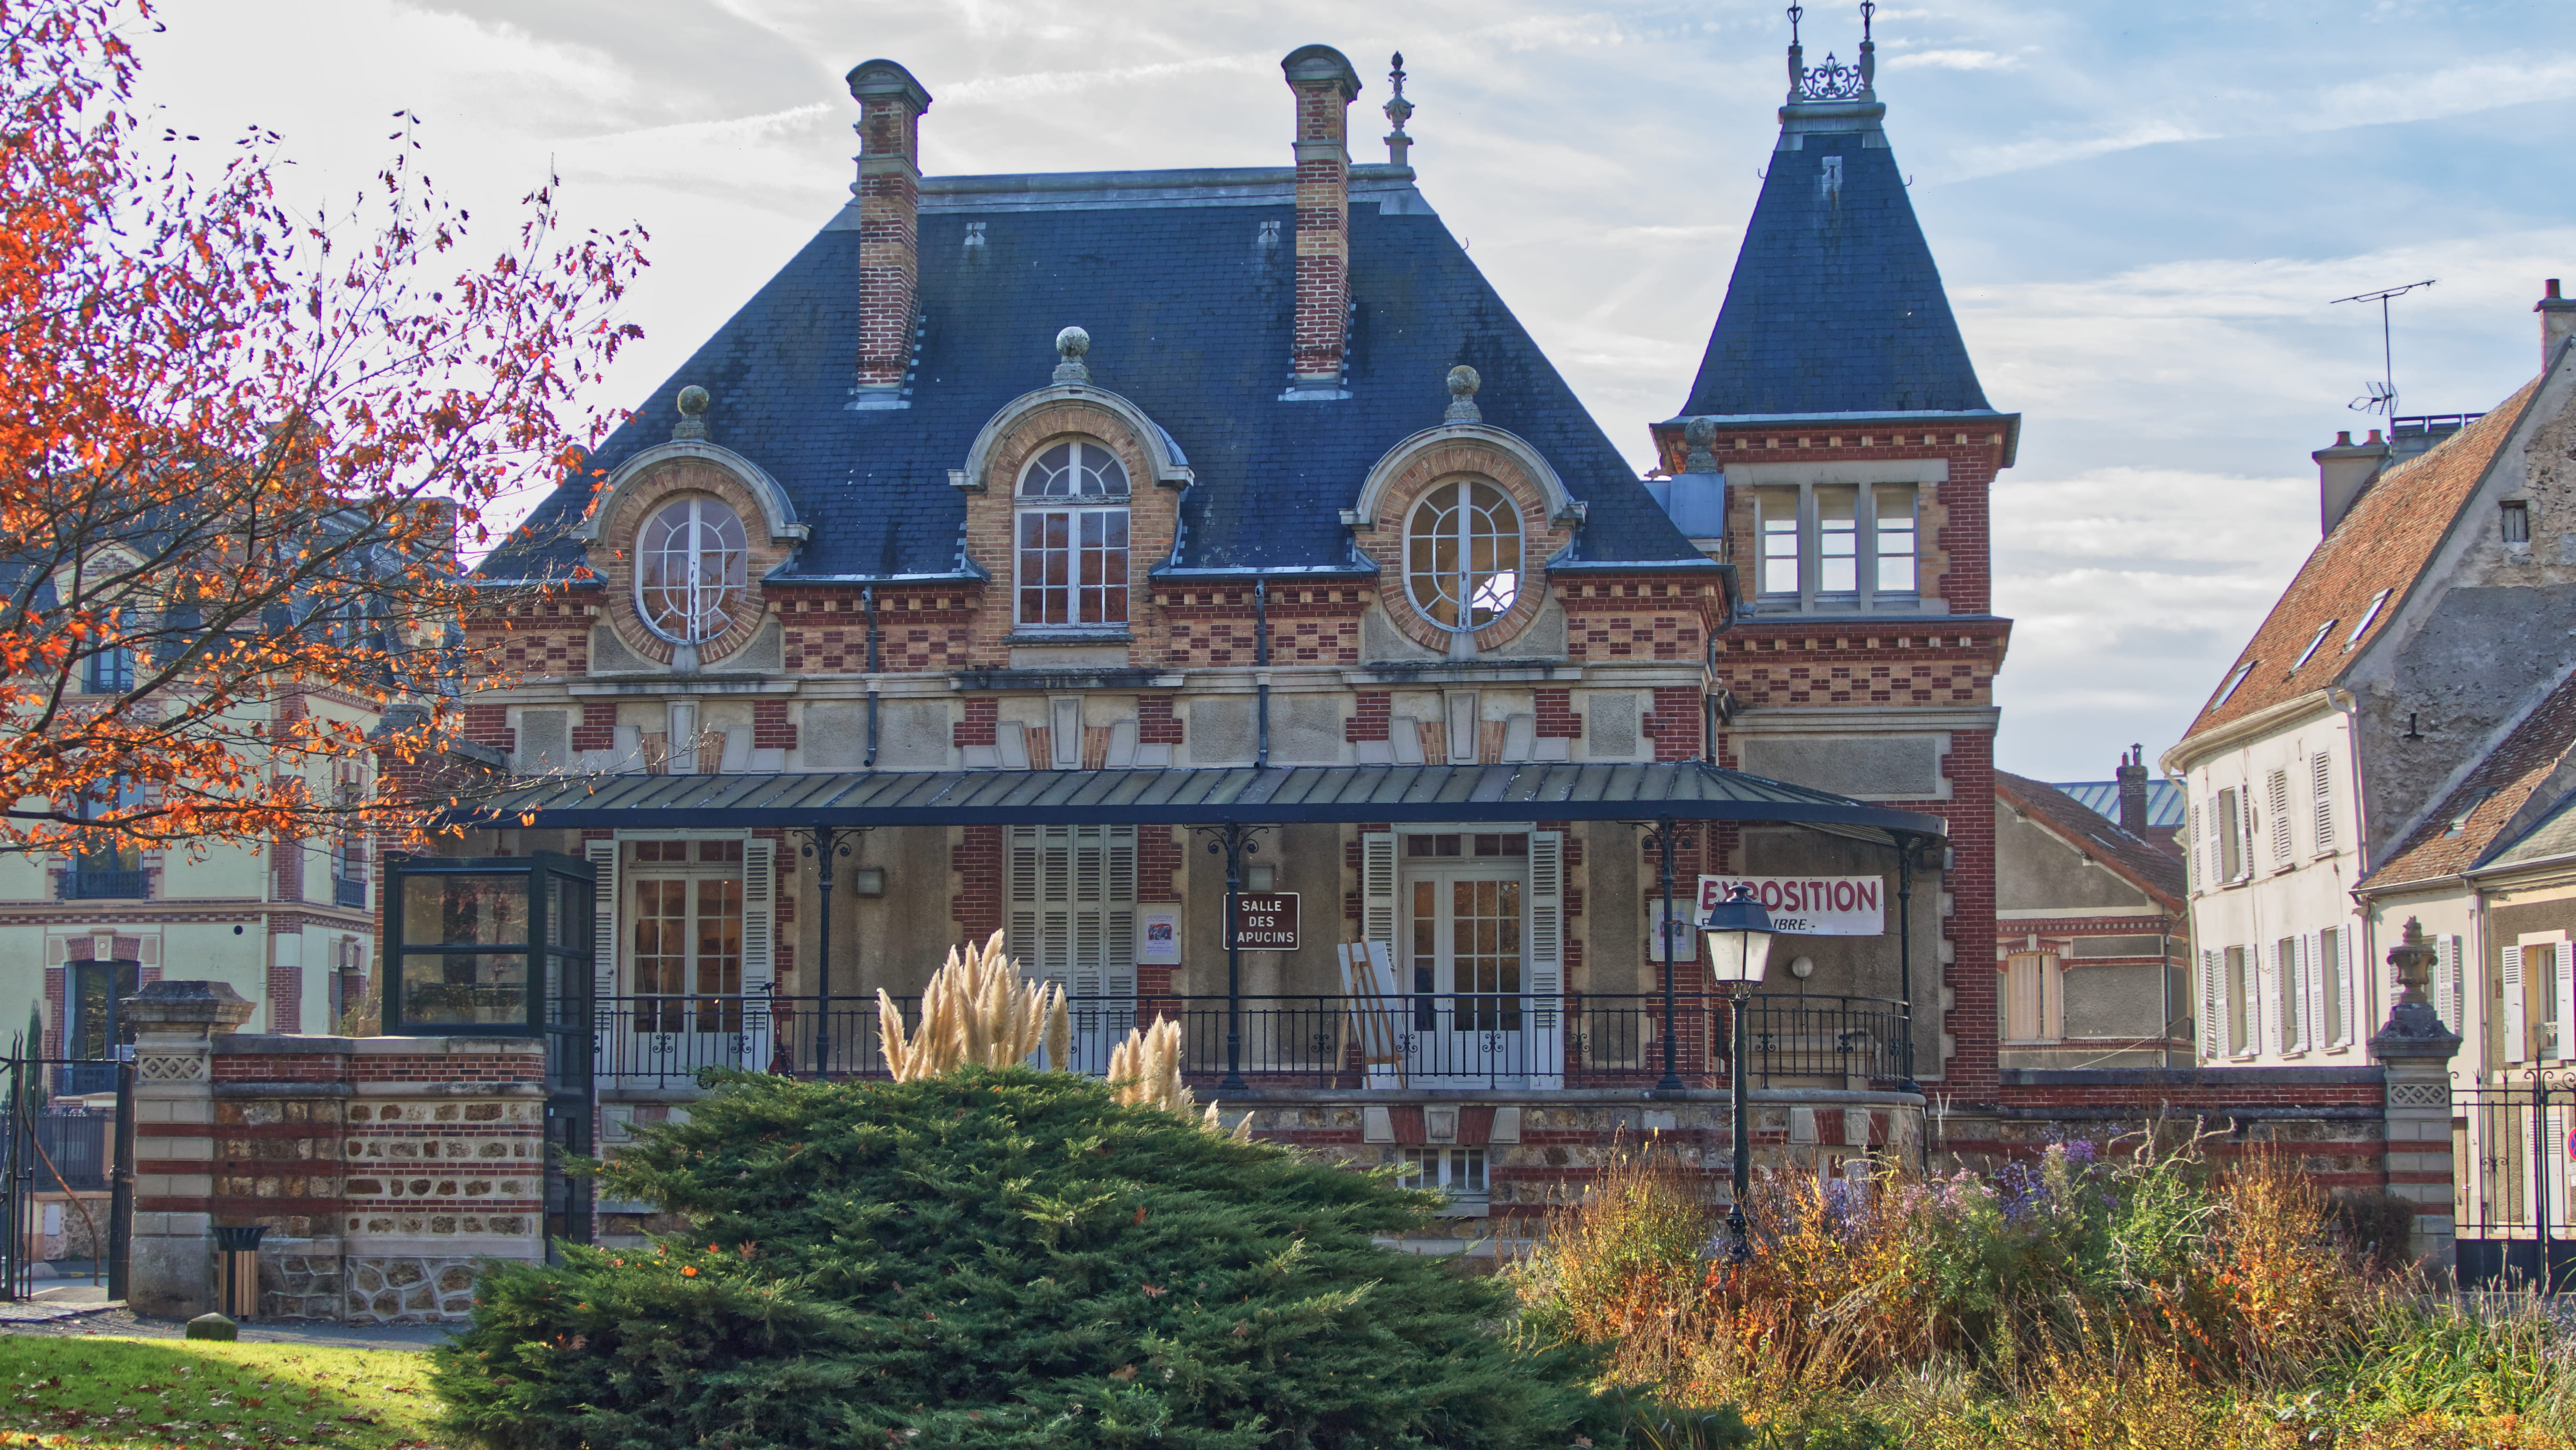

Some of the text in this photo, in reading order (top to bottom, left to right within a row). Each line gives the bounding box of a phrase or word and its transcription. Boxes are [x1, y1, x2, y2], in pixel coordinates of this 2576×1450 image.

[1242, 901, 1281, 911] SALLE
[1249, 916, 1274, 927] DES
[1773, 919, 1807, 930] IBRE
[1228, 932, 1294, 942] APUCINS
